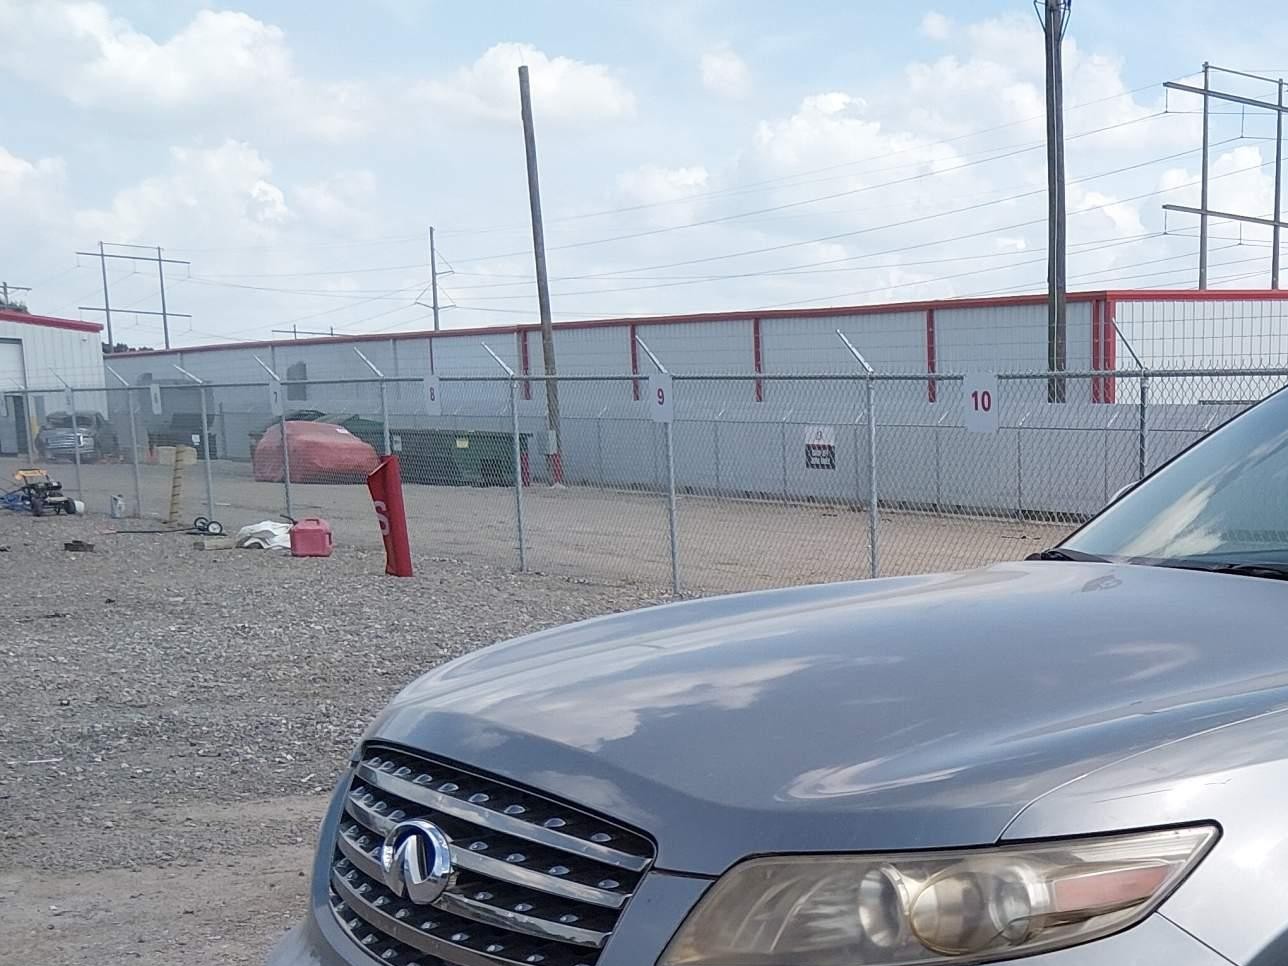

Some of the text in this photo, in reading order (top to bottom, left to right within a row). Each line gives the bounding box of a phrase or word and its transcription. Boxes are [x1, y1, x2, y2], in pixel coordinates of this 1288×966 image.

[429, 386, 436, 401] 8
[657, 387, 665, 405] 9
[971, 390, 992, 412] 10
